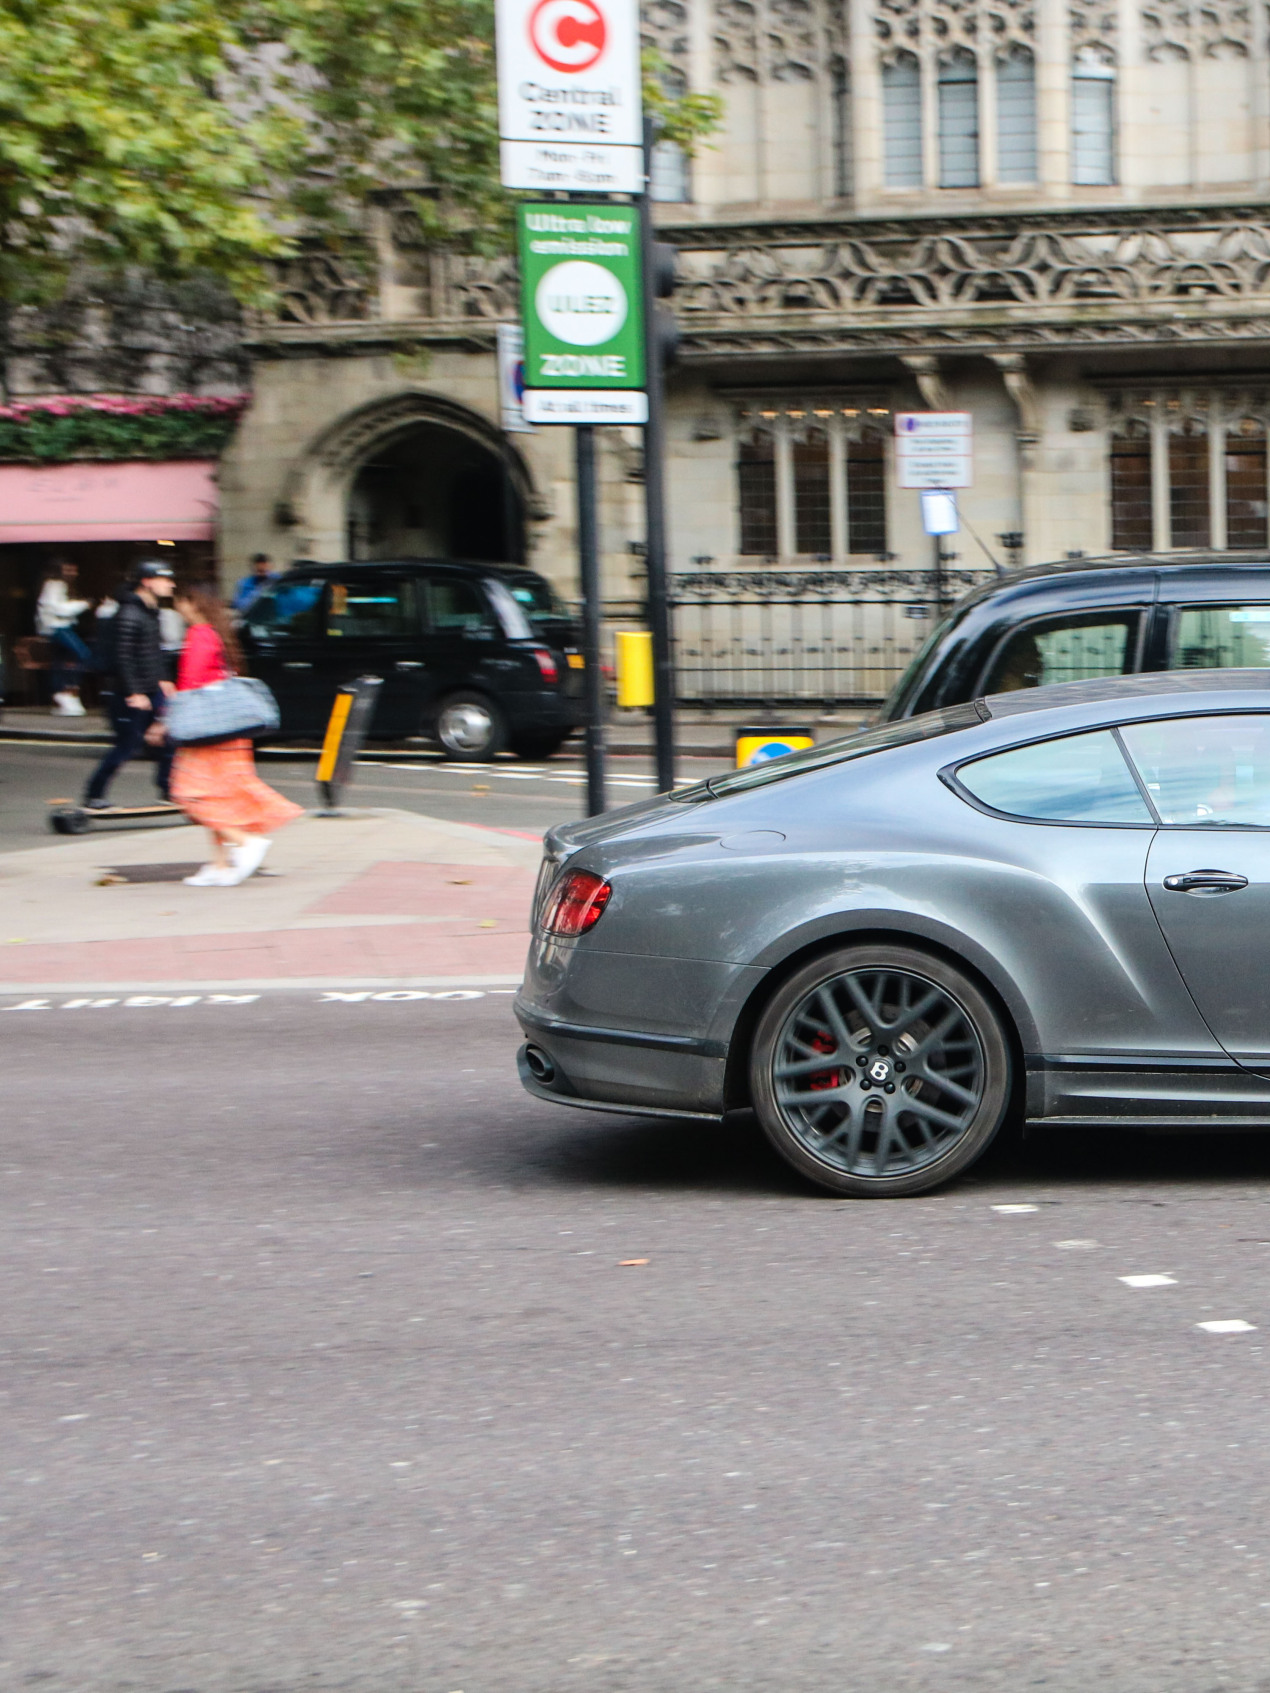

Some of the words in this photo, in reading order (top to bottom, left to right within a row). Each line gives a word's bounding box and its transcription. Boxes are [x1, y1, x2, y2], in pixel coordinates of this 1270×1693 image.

[518, 80, 622, 106] Central
[530, 110, 612, 133] ZONE
[529, 237, 629, 257] emission
[547, 296, 618, 314] ULEZ
[540, 354, 628, 378] ZONE
